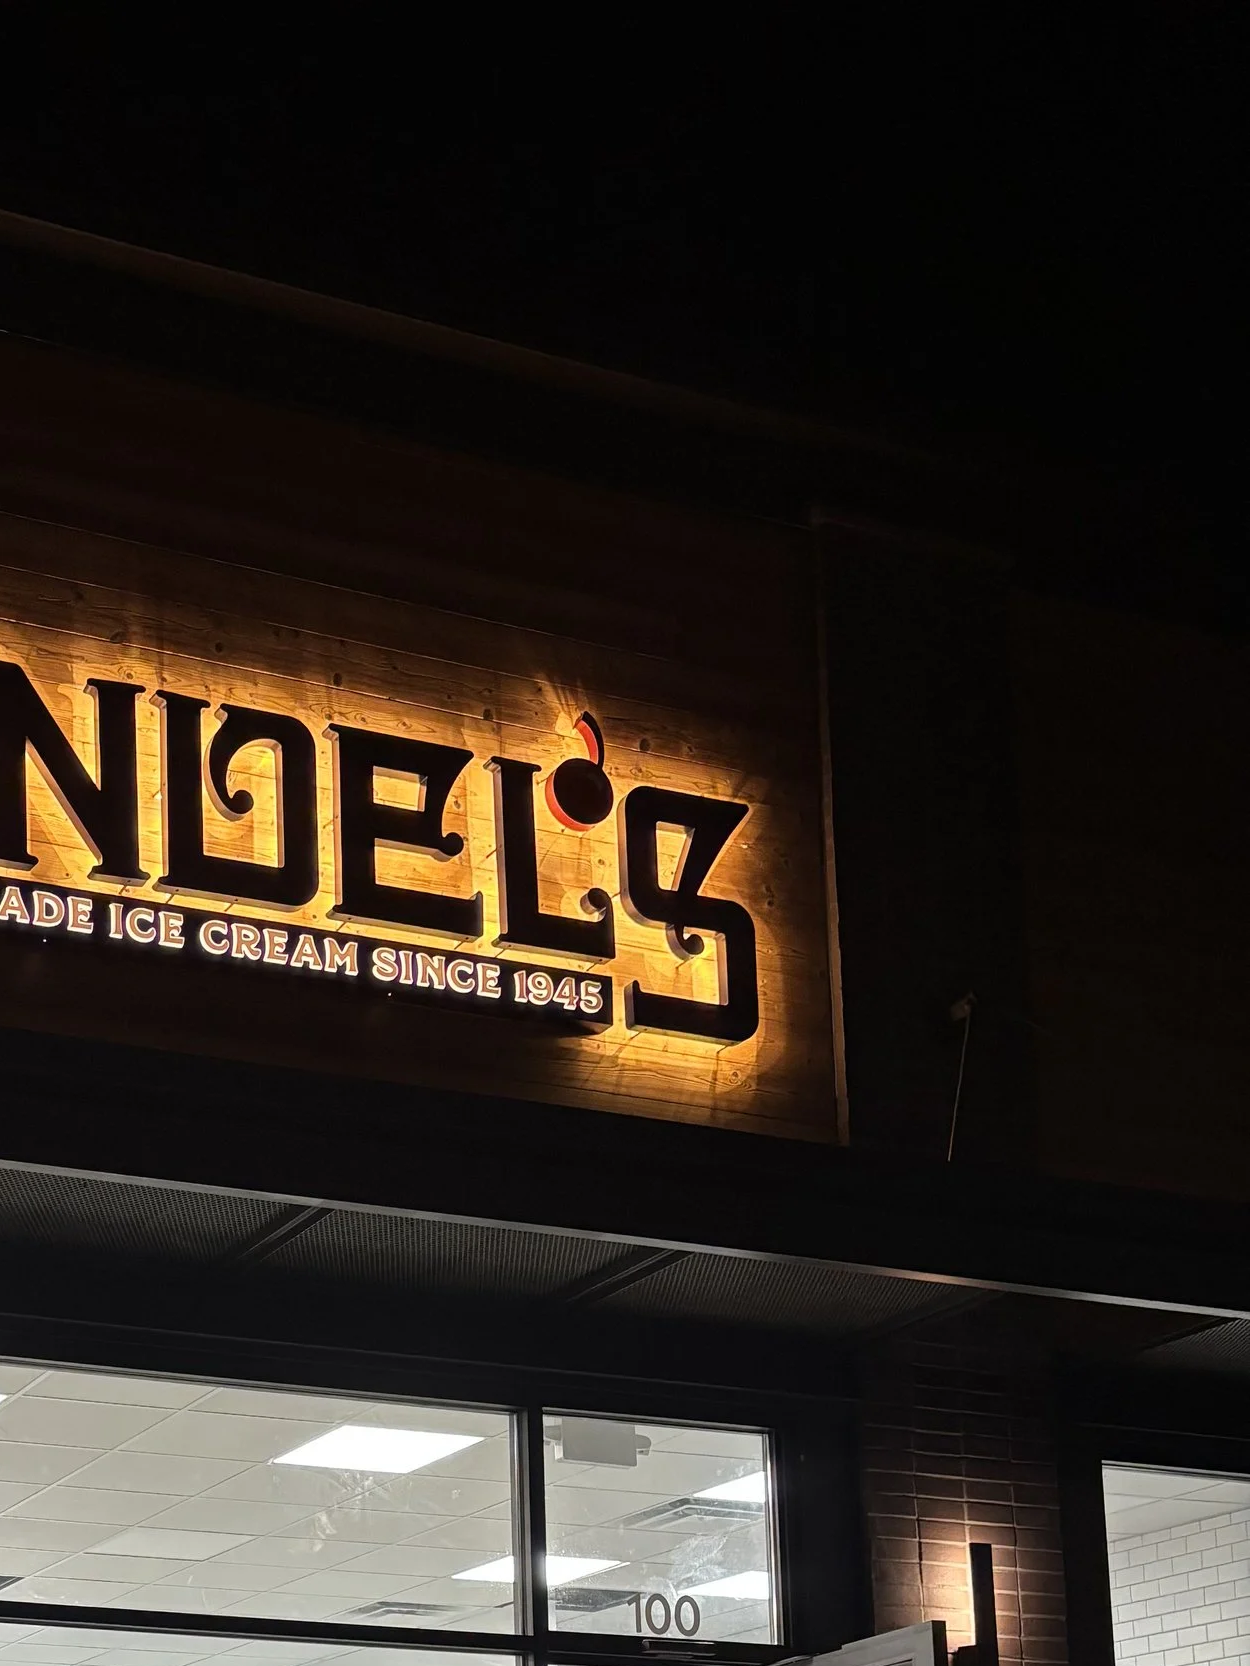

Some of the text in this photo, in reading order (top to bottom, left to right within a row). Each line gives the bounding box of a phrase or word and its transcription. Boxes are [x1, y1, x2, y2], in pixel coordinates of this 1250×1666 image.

[108, 902, 186, 949] ICE
[198, 919, 359, 976] CREAM
[371, 947, 502, 999] SINCE
[513, 970, 603, 1013] 1945
[627, 1592, 700, 1637] 100
